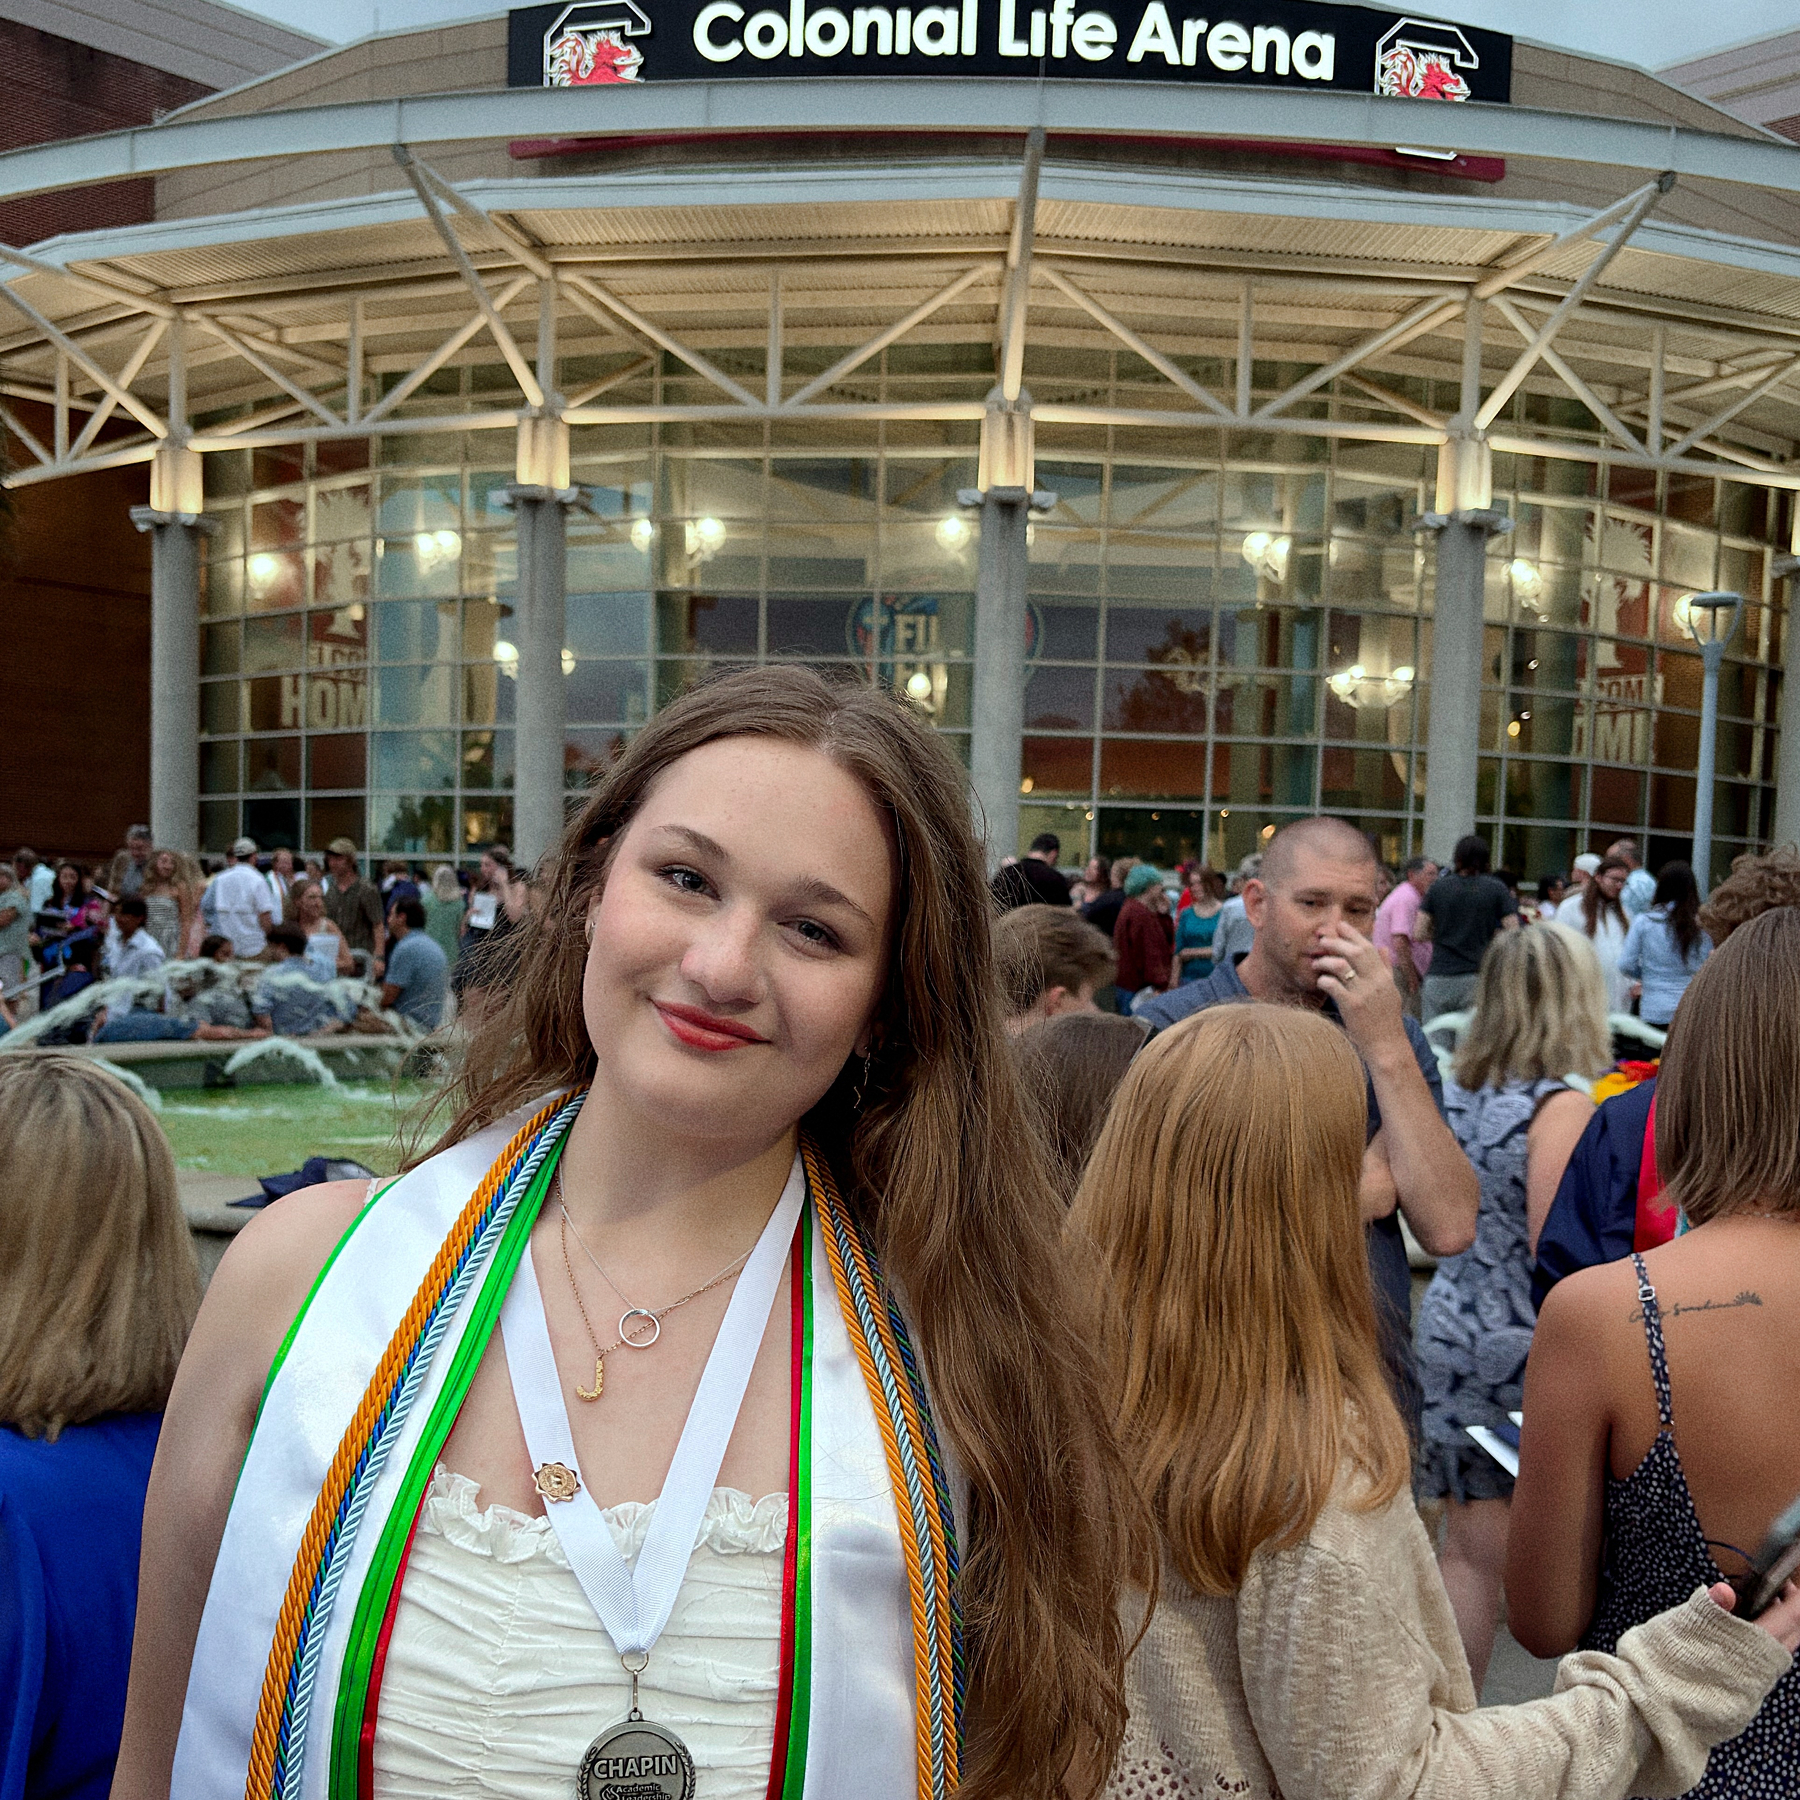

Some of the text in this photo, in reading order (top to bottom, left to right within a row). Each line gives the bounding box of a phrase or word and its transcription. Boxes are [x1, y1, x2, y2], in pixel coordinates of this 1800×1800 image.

[692, 0, 1336, 81] Colonial Life Arena
[281, 675, 367, 727] HOM
[593, 1755, 678, 1779] CHAPIN
[616, 1783, 661, 1794] Academic
